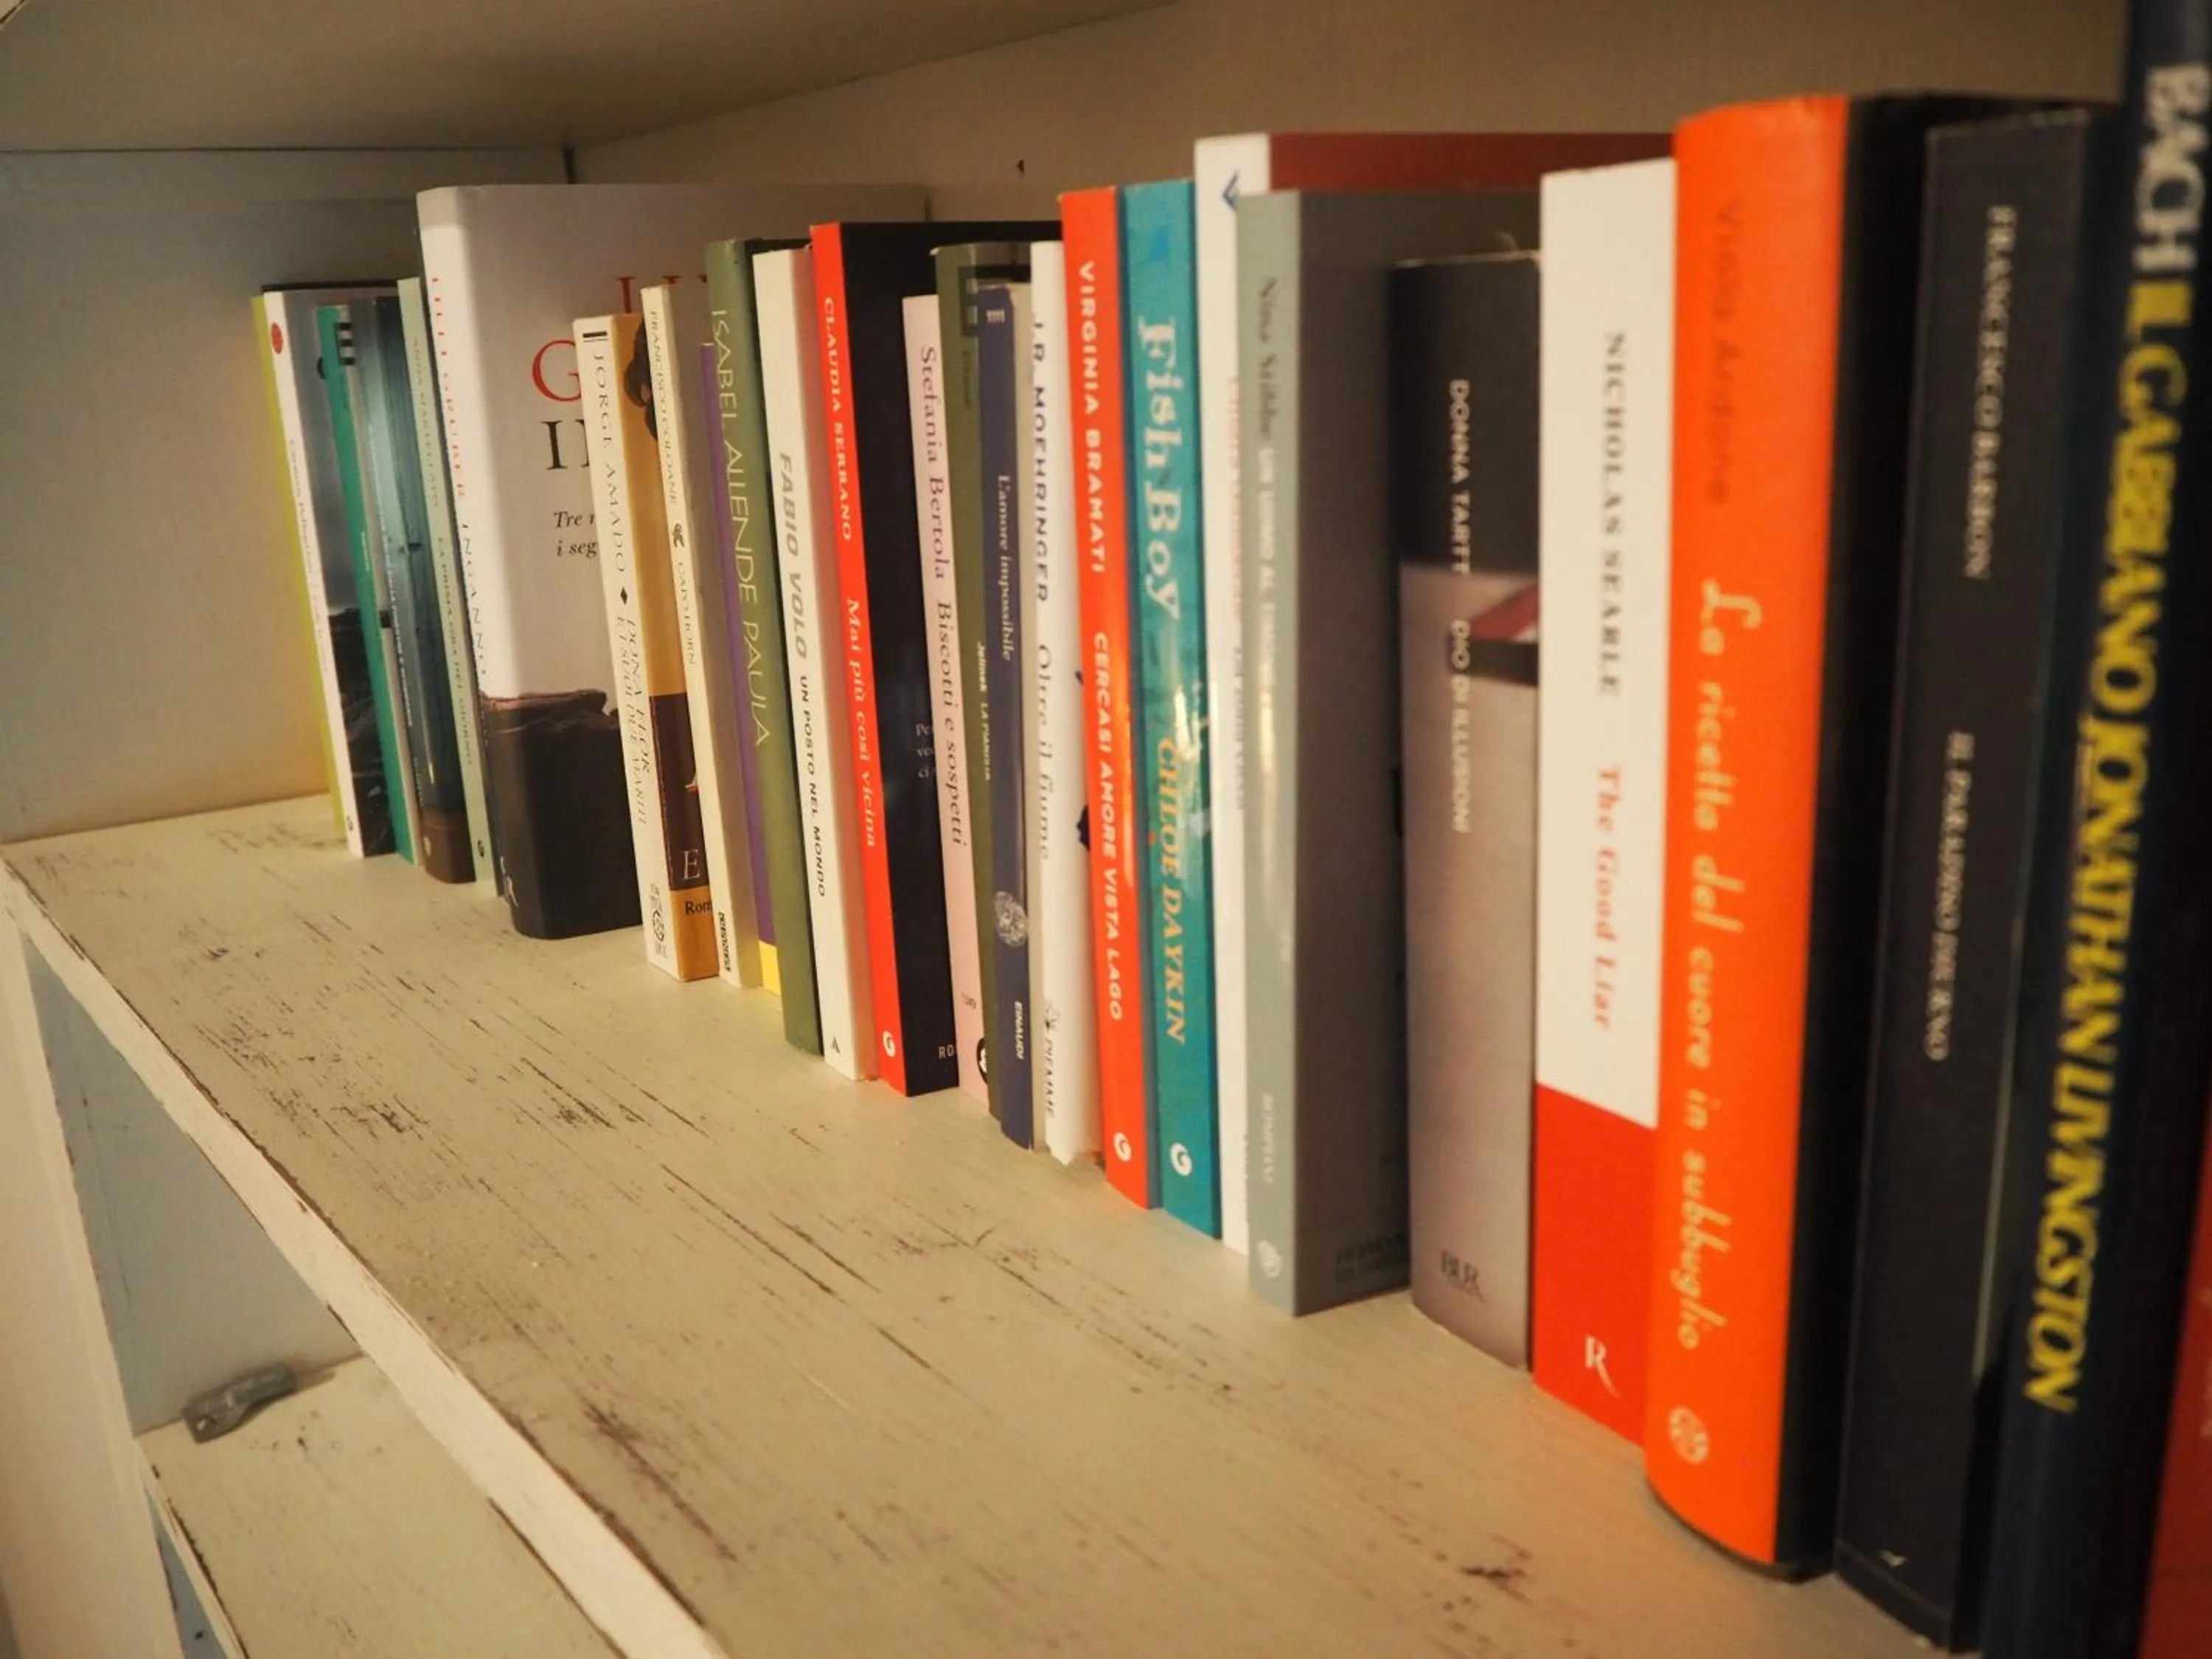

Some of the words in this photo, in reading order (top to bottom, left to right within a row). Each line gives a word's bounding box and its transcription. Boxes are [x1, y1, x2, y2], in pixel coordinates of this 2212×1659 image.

[2132, 63, 2212, 274] BACH
[649, 310, 669, 414] FRANCISCO
[1079, 262, 1099, 414] VIRGINIA
[1974, 205, 2017, 430] FRANCESCO
[2126, 279, 2193, 345] IL
[712, 310, 737, 419] ISABEL
[919, 346, 943, 463] Stefania
[1138, 317, 1183, 469] Fish
[592, 352, 613, 450] JORGE
[604, 462, 625, 574] AMADO
[825, 296, 841, 413] CLAUDIA
[834, 422, 852, 541] SERRANO
[1450, 379, 1470, 484] DONNA
[1601, 332, 1627, 538] NICHOLAS
[553, 510, 583, 530] Tre
[779, 451, 799, 555] FABIO
[929, 476, 953, 580] Bertola
[997, 474, 1012, 552] L'amore
[1033, 386, 1049, 602] MOEHRINGER
[1085, 429, 1105, 574] BRAMATI
[1451, 490, 1470, 575] TARTT
[2088, 344, 2188, 715] GABBIANO
[677, 560, 692, 616] CAPO
[1144, 481, 1180, 619] Boy
[684, 617, 698, 666] HORN
[788, 572, 808, 661] VOLO
[937, 600, 960, 708] Biscotti
[998, 556, 1015, 661] impossibile
[1599, 549, 1623, 696] SEARLE
[1699, 577, 1763, 656] La
[625, 617, 641, 696] DONA
[636, 708, 651, 774] FLOR
[742, 621, 773, 747] PAULA
[800, 675, 809, 703] UN
[847, 597, 863, 652] Mai
[861, 771, 876, 847] vicina
[944, 717, 956, 731] e
[1037, 643, 1052, 726] Oltre
[1093, 631, 1113, 753] CERCASI
[803, 709, 815, 776] POSTO
[946, 740, 967, 846] sospetti
[1038, 740, 1052, 761] il
[1693, 681, 1739, 832] ricetta
[808, 782, 818, 818] NEL
[1038, 773, 1054, 860] fiume
[1101, 762, 1116, 860] AMORE
[1596, 765, 1622, 835] The
[812, 826, 826, 898] MONDO
[1104, 869, 1119, 940] VISTA
[1595, 847, 1618, 945] Good
[1691, 852, 1747, 935] del
[2059, 714, 2148, 1062] JONATHAN
[1107, 948, 1123, 1020] LAGO
[1161, 885, 1186, 1045] DAYKIN
[1592, 954, 1617, 1033] Liar
[1686, 945, 1714, 1070] cuore
[1015, 1001, 1025, 1060] EINAUDI
[1685, 1088, 1722, 1131] in
[1670, 1149, 1733, 1352] subbuglio
[2023, 1062, 2116, 1413] LIVINGSTON
